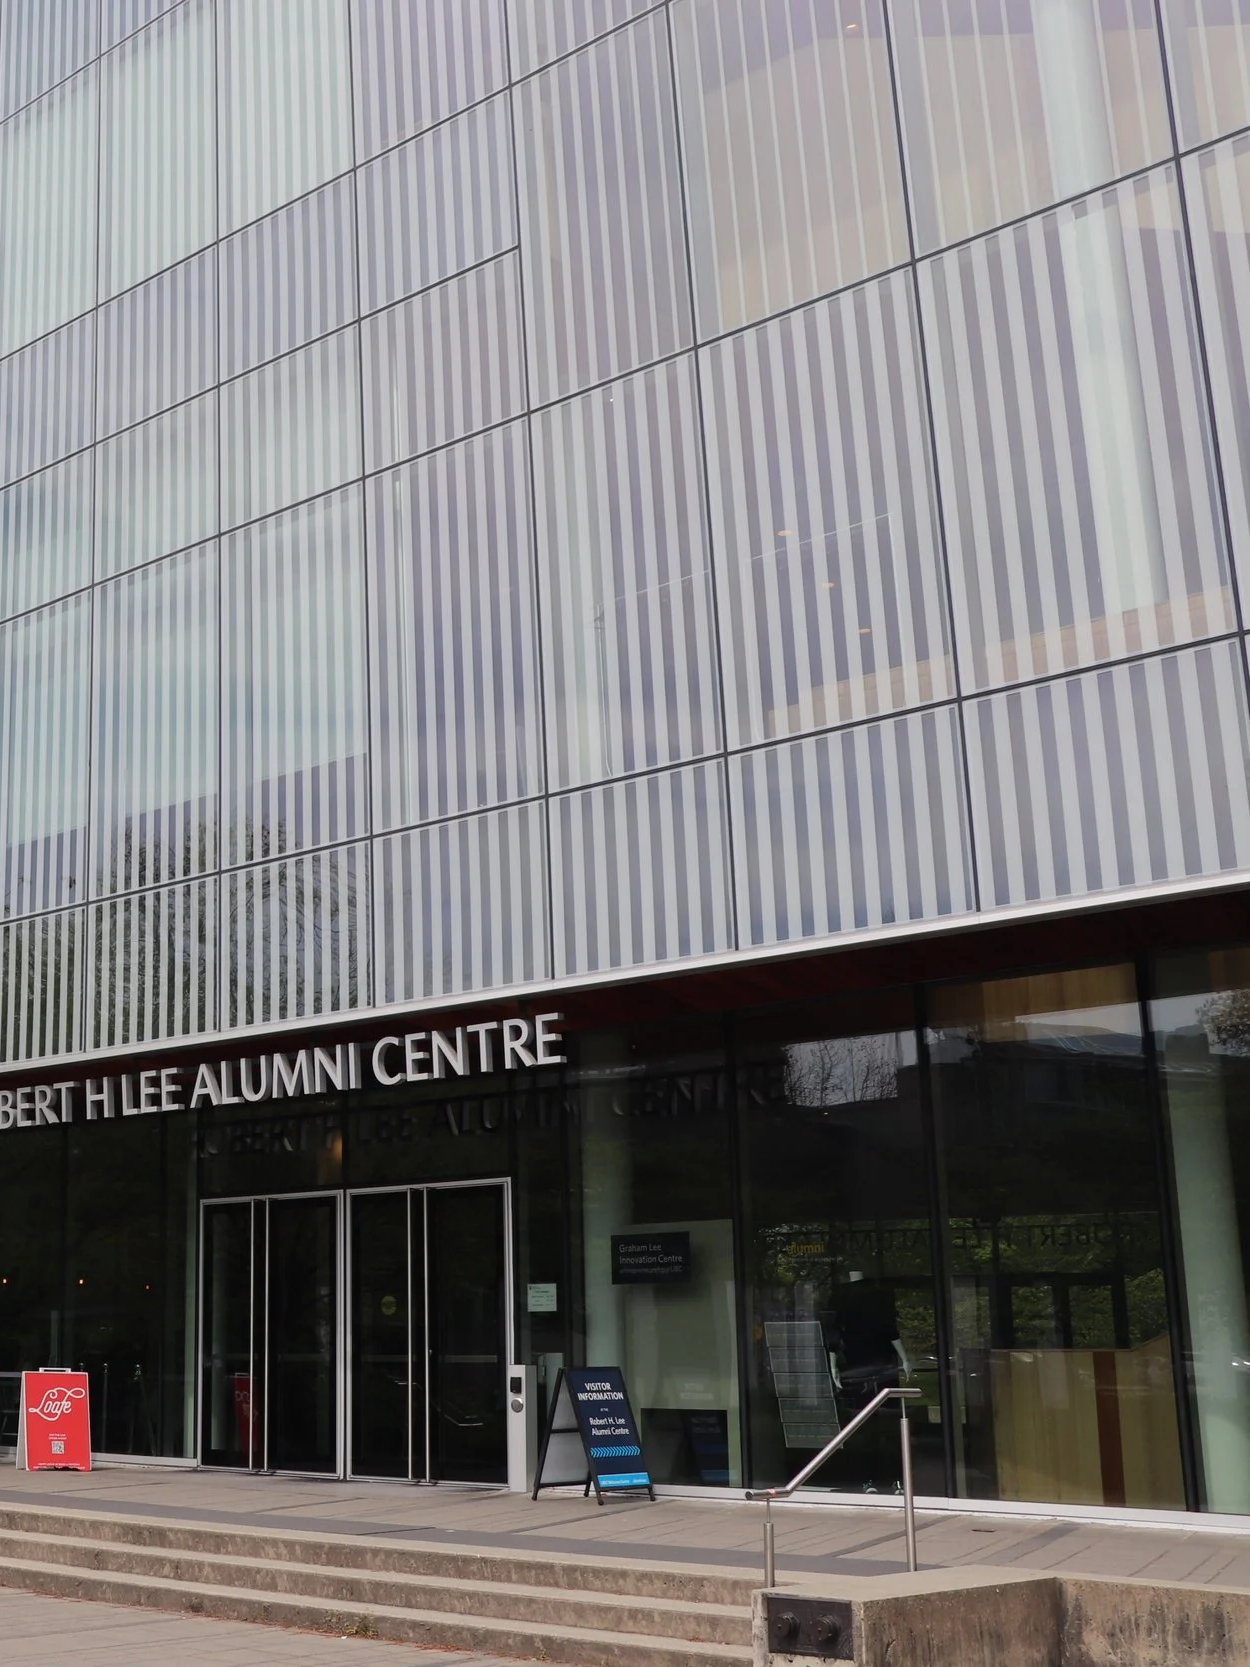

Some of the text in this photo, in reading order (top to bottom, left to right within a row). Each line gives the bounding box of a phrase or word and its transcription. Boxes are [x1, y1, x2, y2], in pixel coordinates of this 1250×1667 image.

[86, 1076, 114, 1120] H
[122, 1067, 185, 1116] LEE
[190, 1042, 361, 1108] ALUMNI
[372, 1012, 567, 1085] CENTRE
[619, 1243, 662, 1253] Graham Lee
[620, 1254, 683, 1265] Innovation Centre
[584, 1382, 611, 1391] VISITOR
[577, 1392, 624, 1401] INFORMATION
[29, 1387, 86, 1422] Loafe
[589, 1417, 626, 1425] Robert H. Lee
[591, 1427, 629, 1436] Alumni Centre
